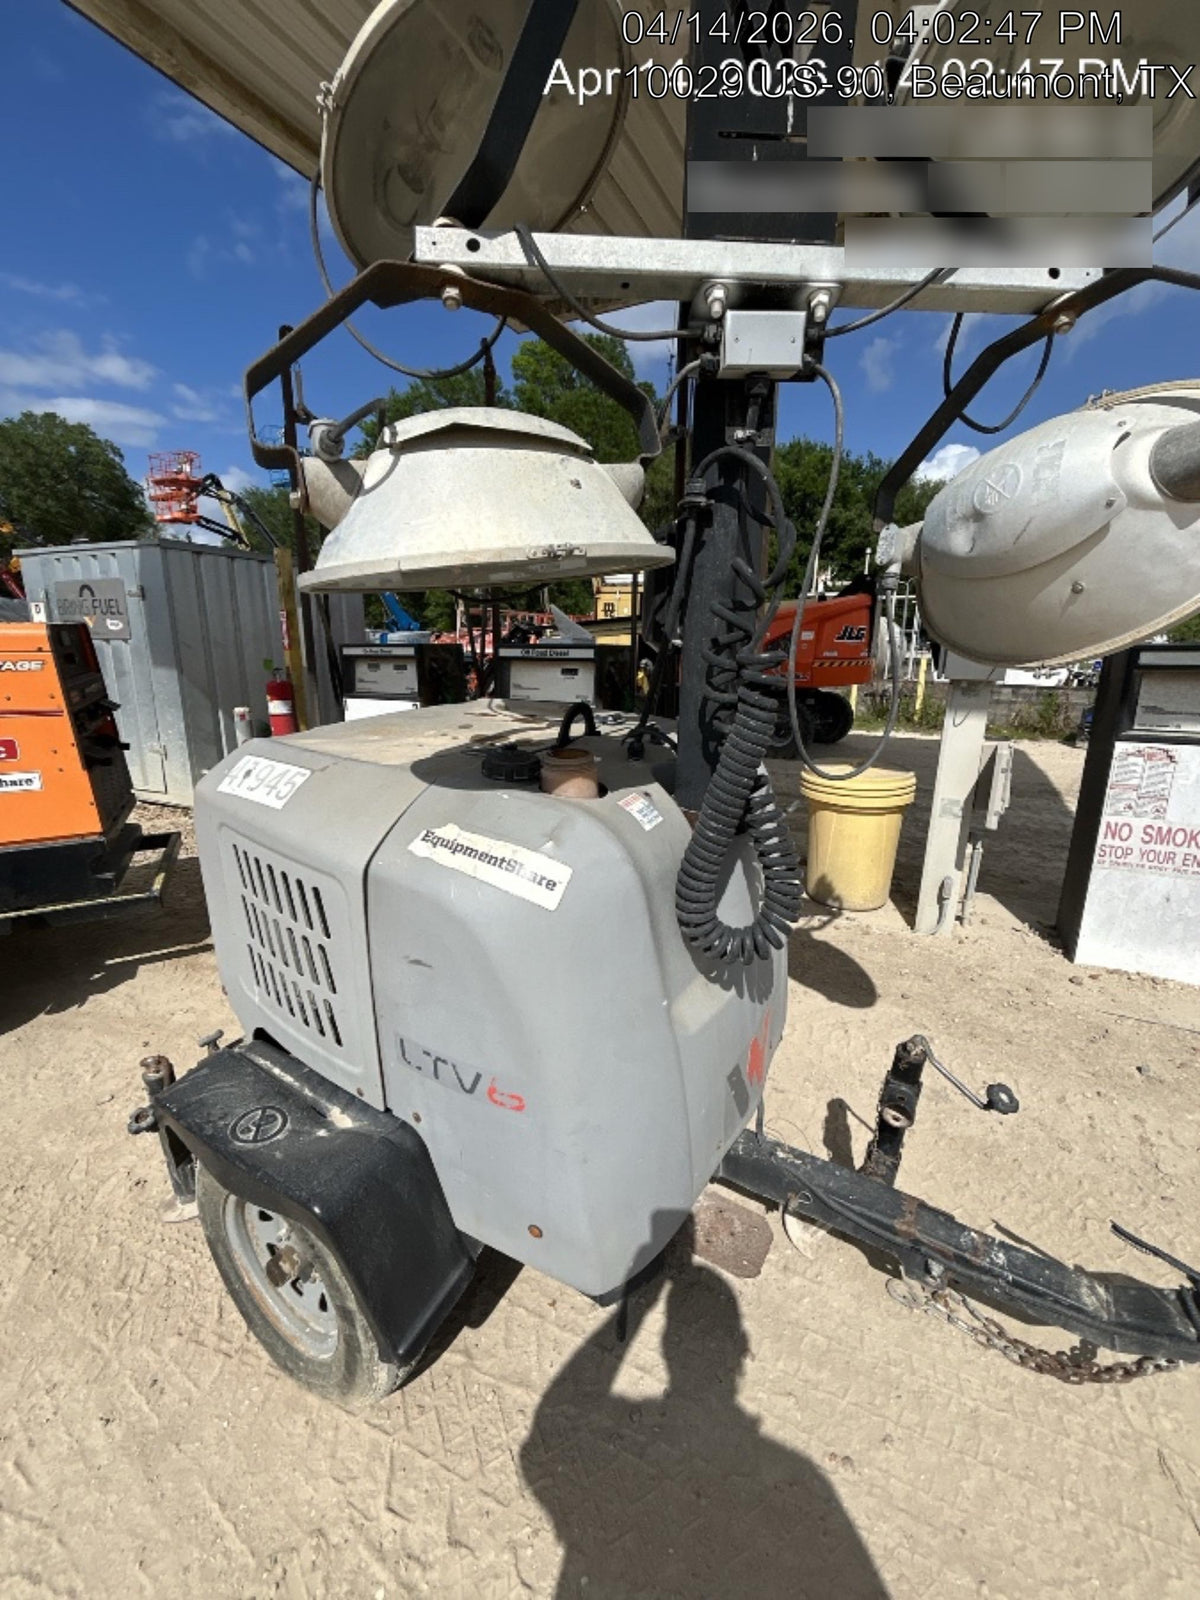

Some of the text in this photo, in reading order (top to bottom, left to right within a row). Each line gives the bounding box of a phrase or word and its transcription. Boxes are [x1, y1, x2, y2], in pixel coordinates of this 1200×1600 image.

[92, 598, 124, 615] FUEL
[0, 660, 43, 671] AGE
[1103, 821, 1200, 849] NO SMOK
[1098, 843, 1134, 860] STOP
[1140, 847, 1176, 865] YOUR
